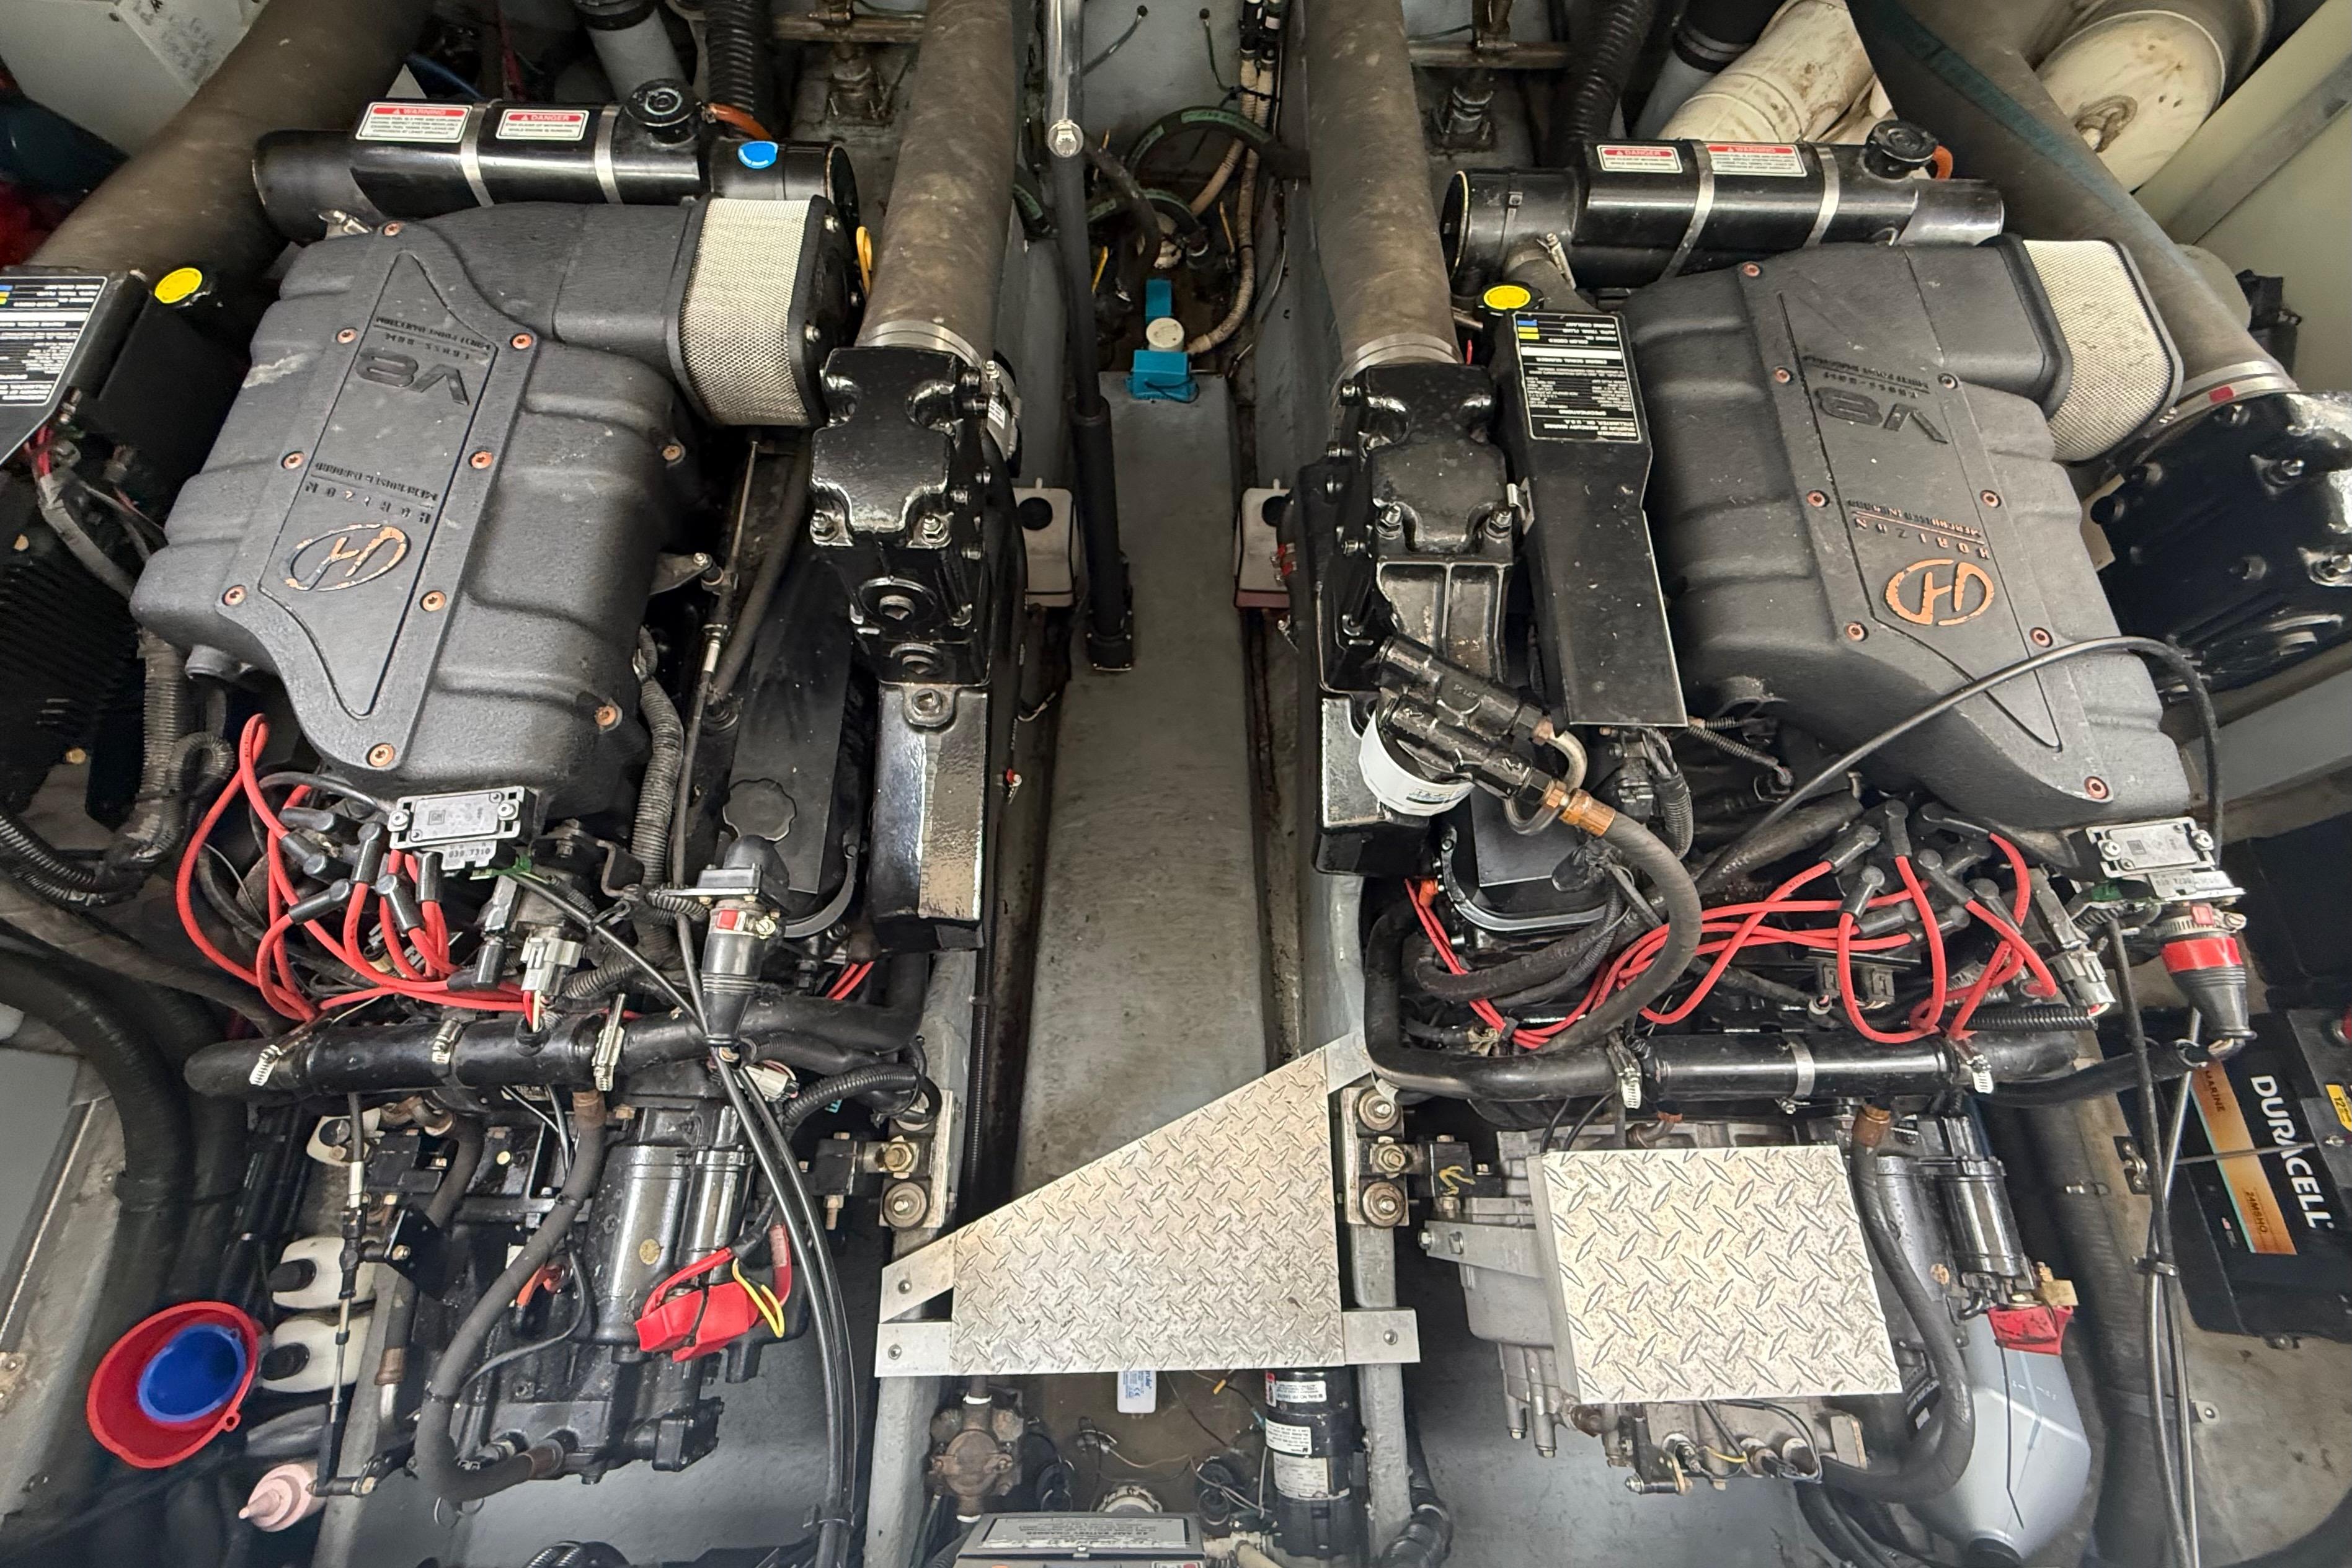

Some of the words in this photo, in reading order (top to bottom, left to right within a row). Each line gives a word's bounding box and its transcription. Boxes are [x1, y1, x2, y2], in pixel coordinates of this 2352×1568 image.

[355, 348, 470, 407] V8
[1854, 518, 1990, 560] HORIZON
[2250, 1075, 2332, 1229] DURACELL
